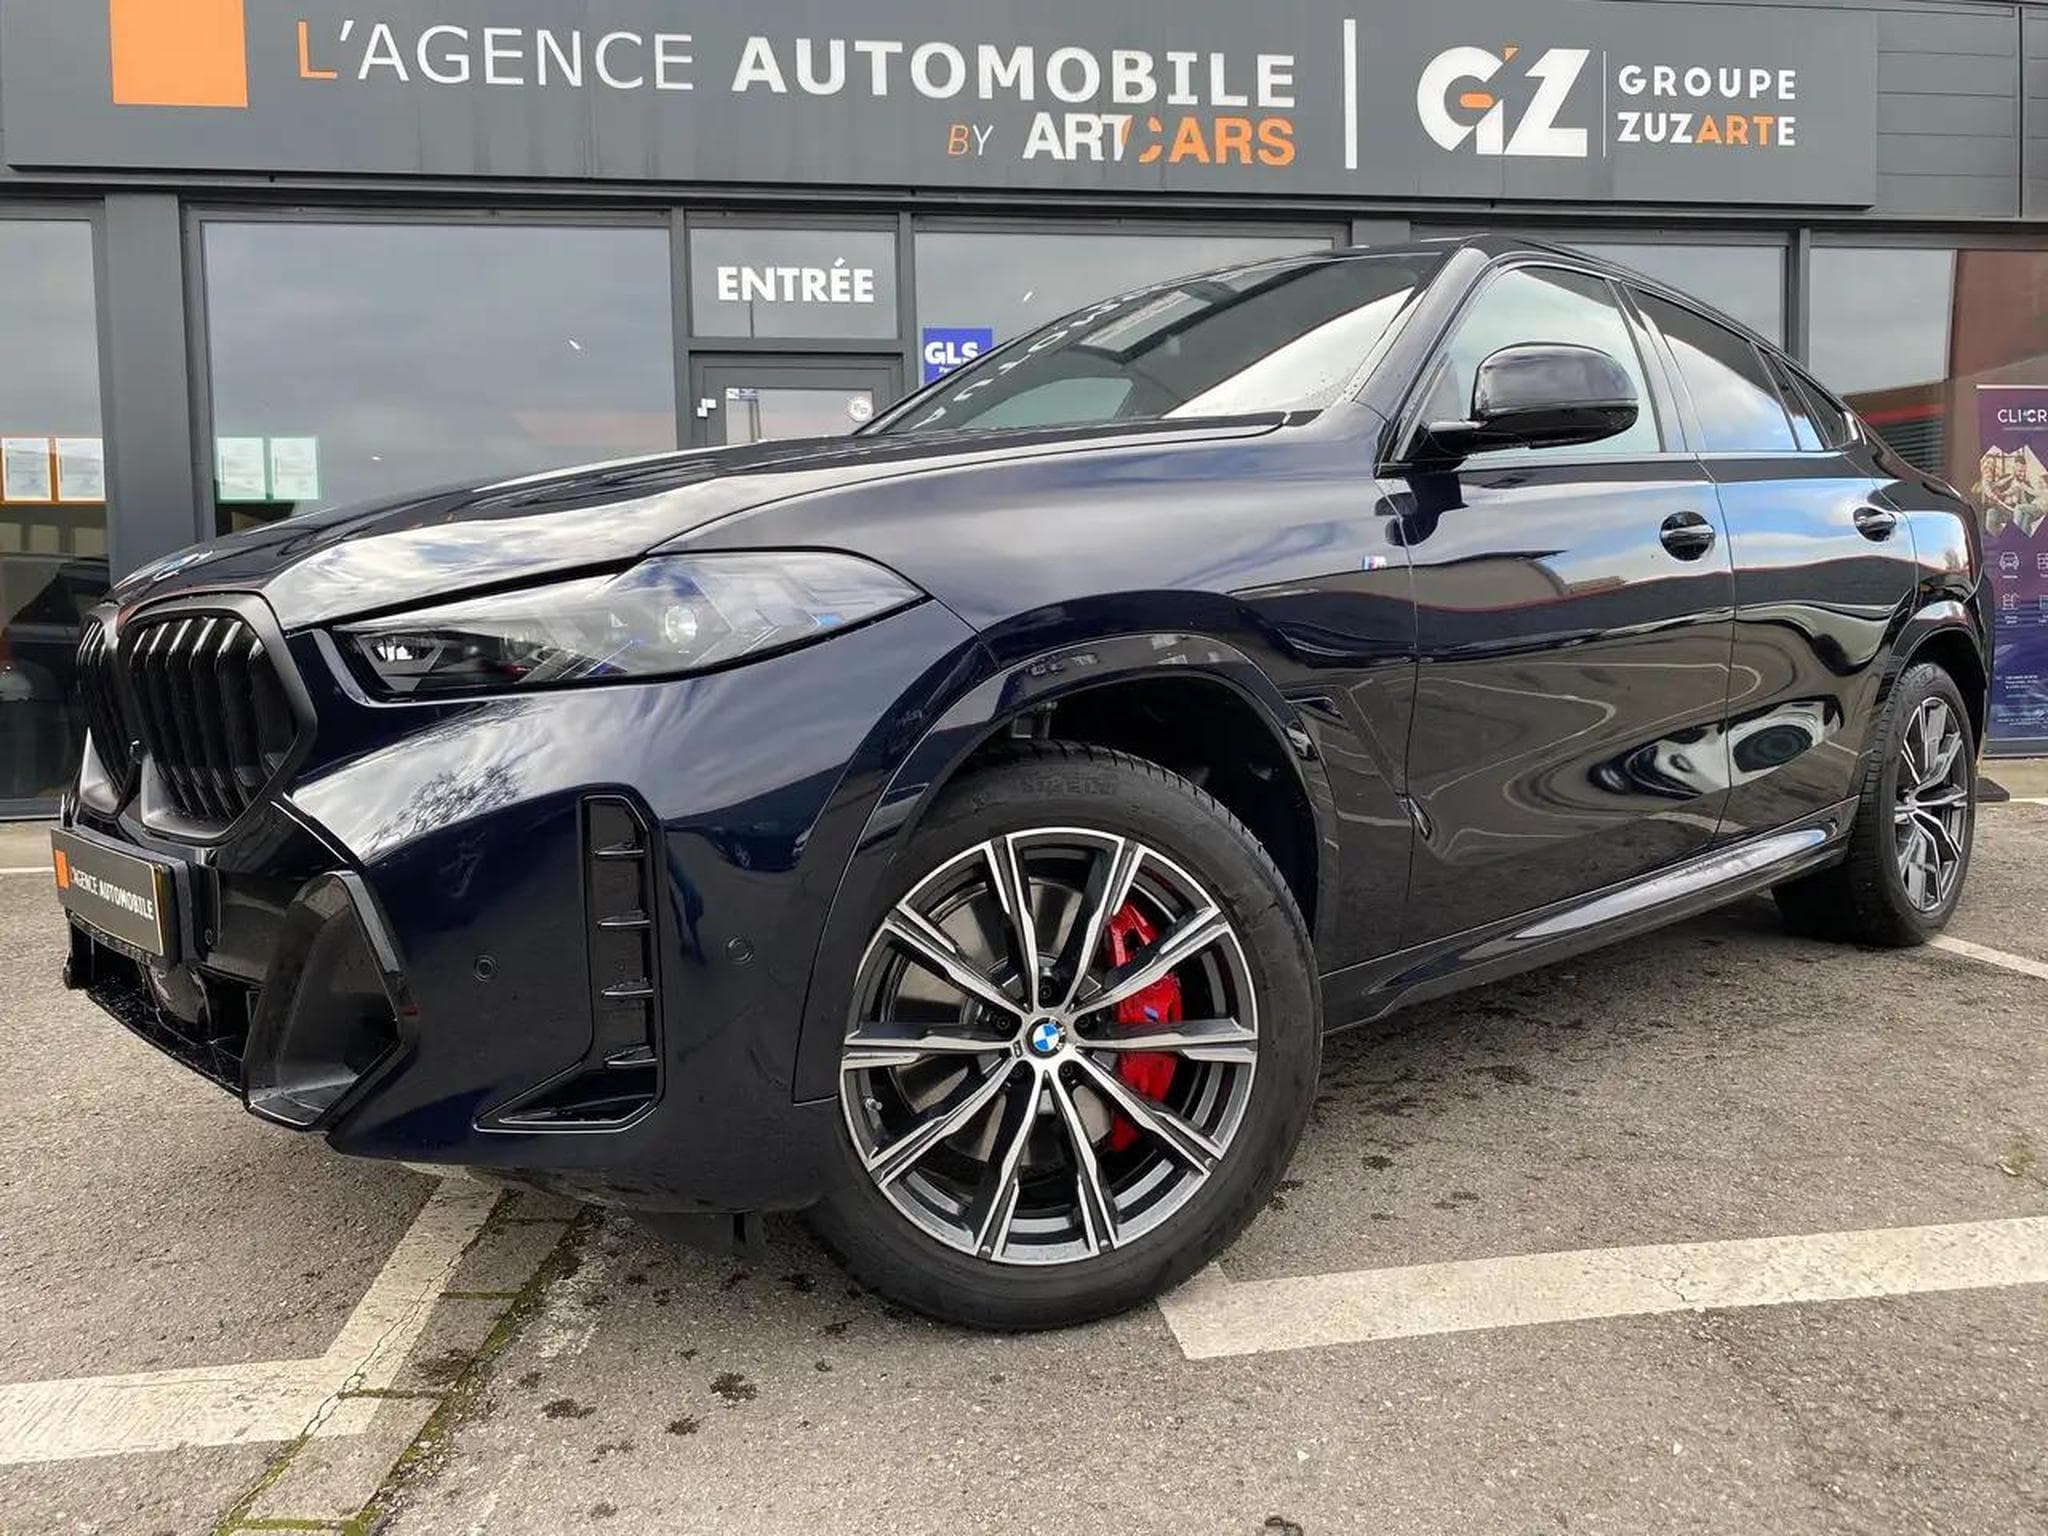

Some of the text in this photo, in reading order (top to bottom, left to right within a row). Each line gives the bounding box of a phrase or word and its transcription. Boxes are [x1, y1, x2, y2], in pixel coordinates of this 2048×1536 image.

[297, 20, 1296, 109] L'AGENCE AUTOMOBILE
[1618, 64, 1796, 101] GROUPE
[947, 112, 1297, 167] BY ARTCARS
[1617, 111, 1796, 147] ZUZARTE
[716, 256, 875, 303] ENTRÉE
[924, 341, 979, 365] GLS
[99, 879, 155, 921] AUTOMOBILE
